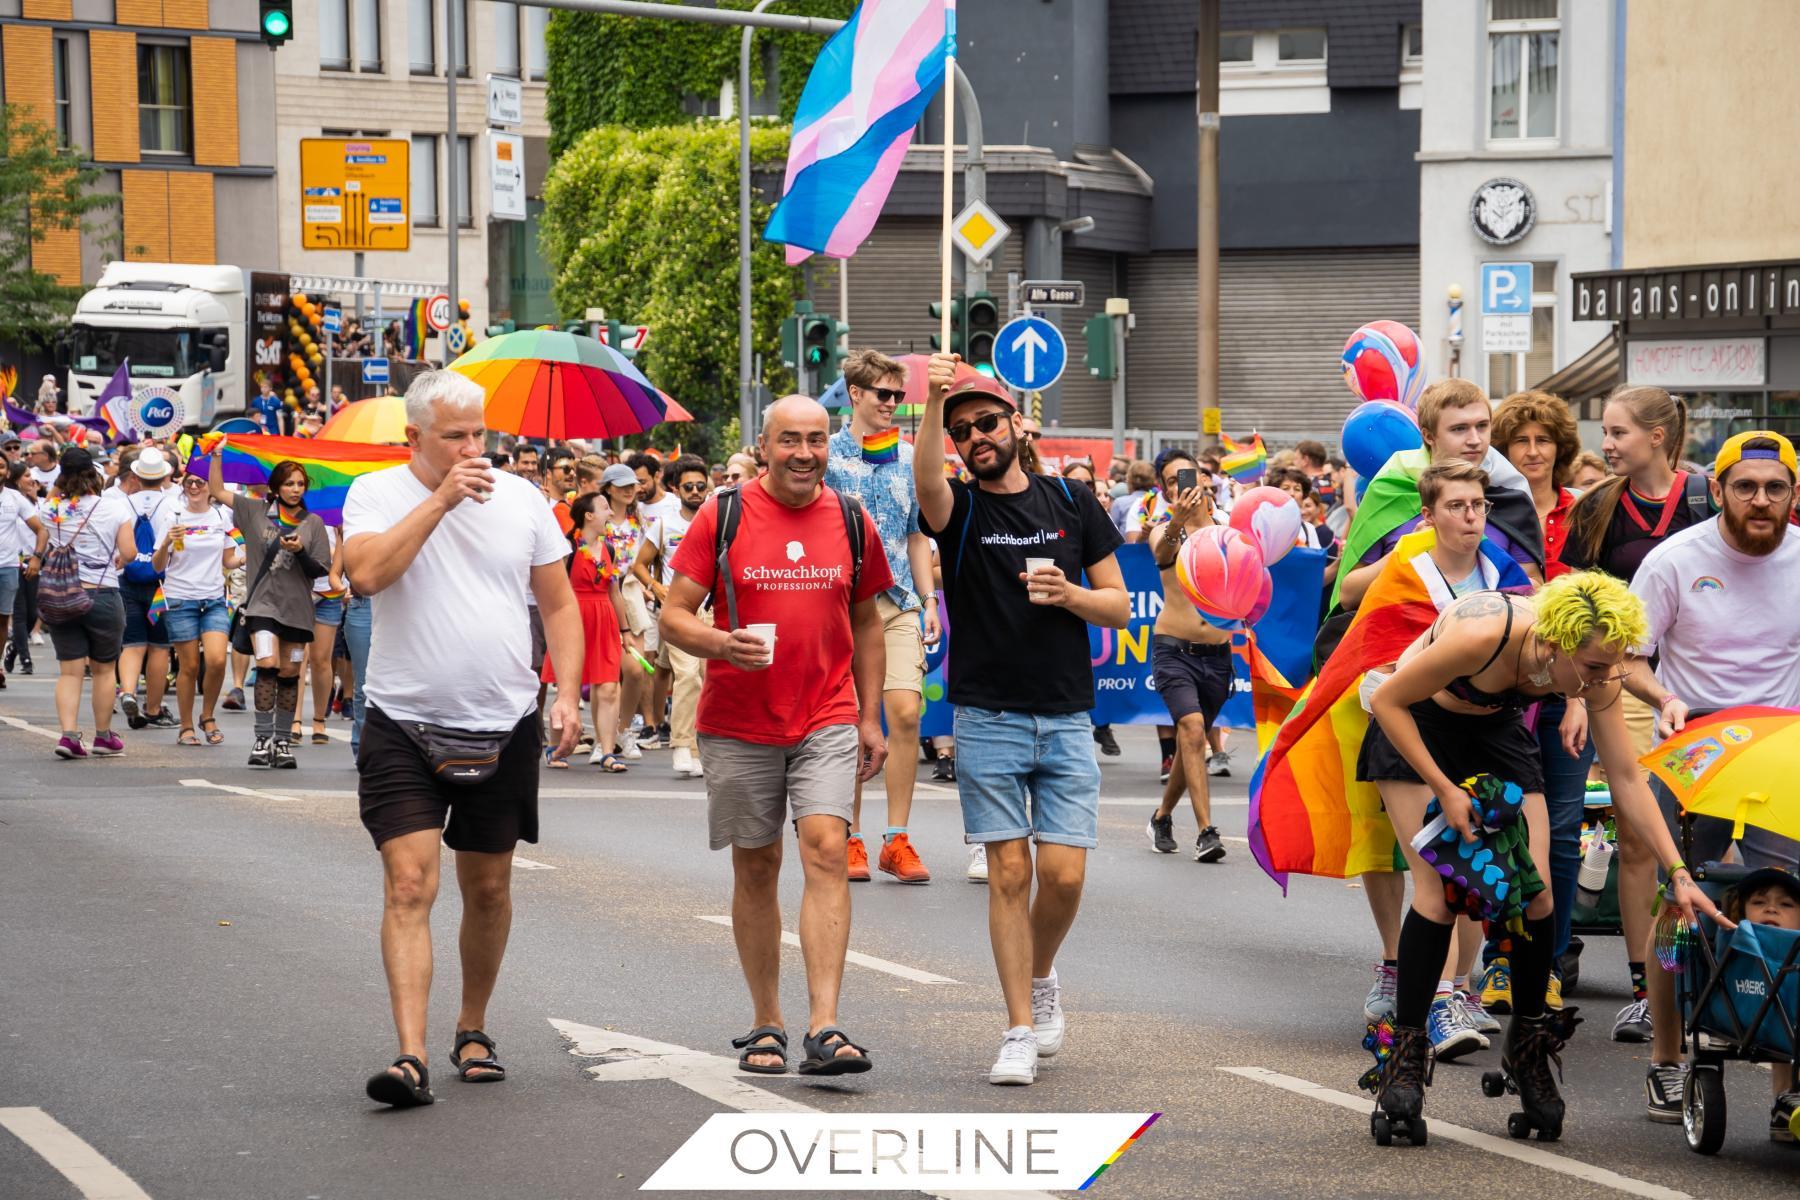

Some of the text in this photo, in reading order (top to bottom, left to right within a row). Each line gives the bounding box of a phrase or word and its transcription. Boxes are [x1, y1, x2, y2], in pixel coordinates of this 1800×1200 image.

[1050, 288, 1075, 301] Gasse
[1489, 270, 1517, 309] P
[434, 304, 450, 319] 40
[147, 406, 172, 418] P&G
[981, 532, 1041, 546] switchboard
[743, 565, 843, 581] Schwachkopf
[756, 582, 833, 591] PROFESSIONAL
